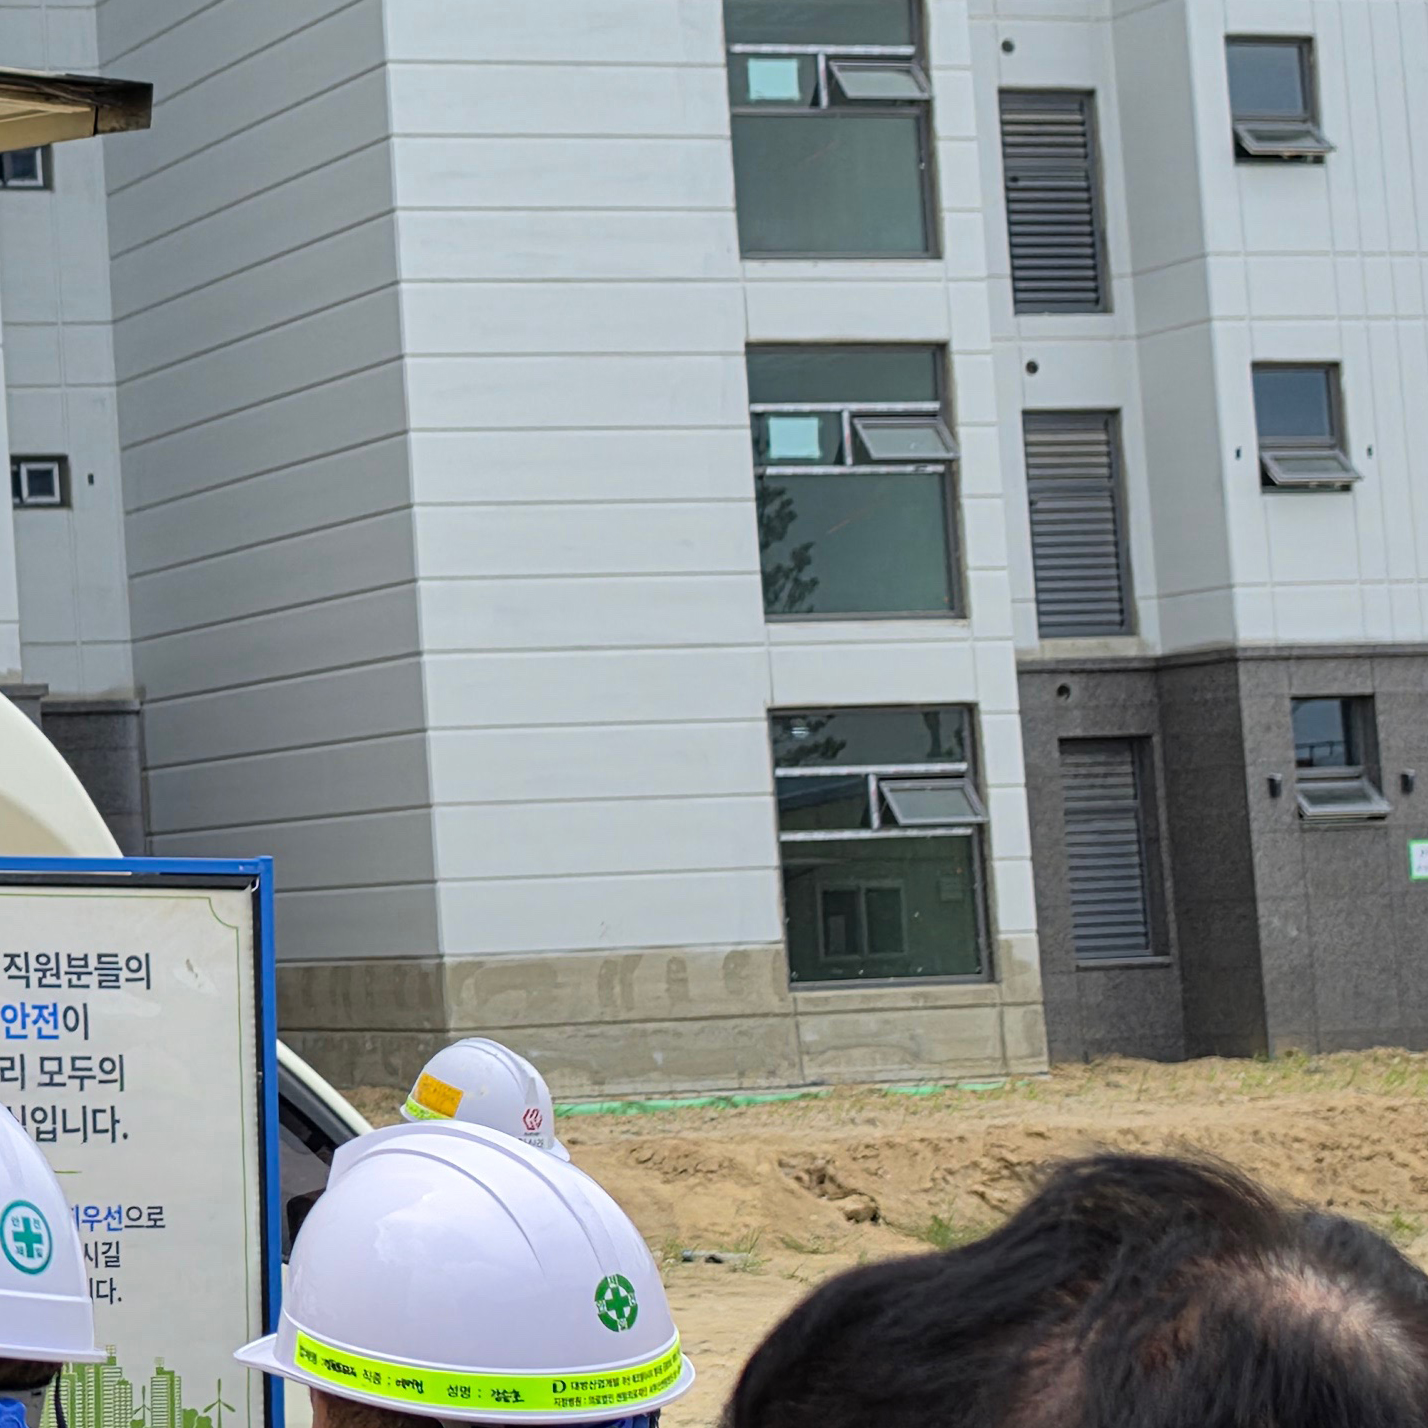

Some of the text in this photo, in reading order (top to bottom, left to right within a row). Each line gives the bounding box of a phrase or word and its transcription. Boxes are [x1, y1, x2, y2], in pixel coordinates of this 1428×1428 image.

[3, 951, 152, 992] 직원분들의
[0, 1002, 90, 1042] 안전이
[37, 1054, 125, 1093] 모두의
[447, 1384, 471, 1399] 성명
